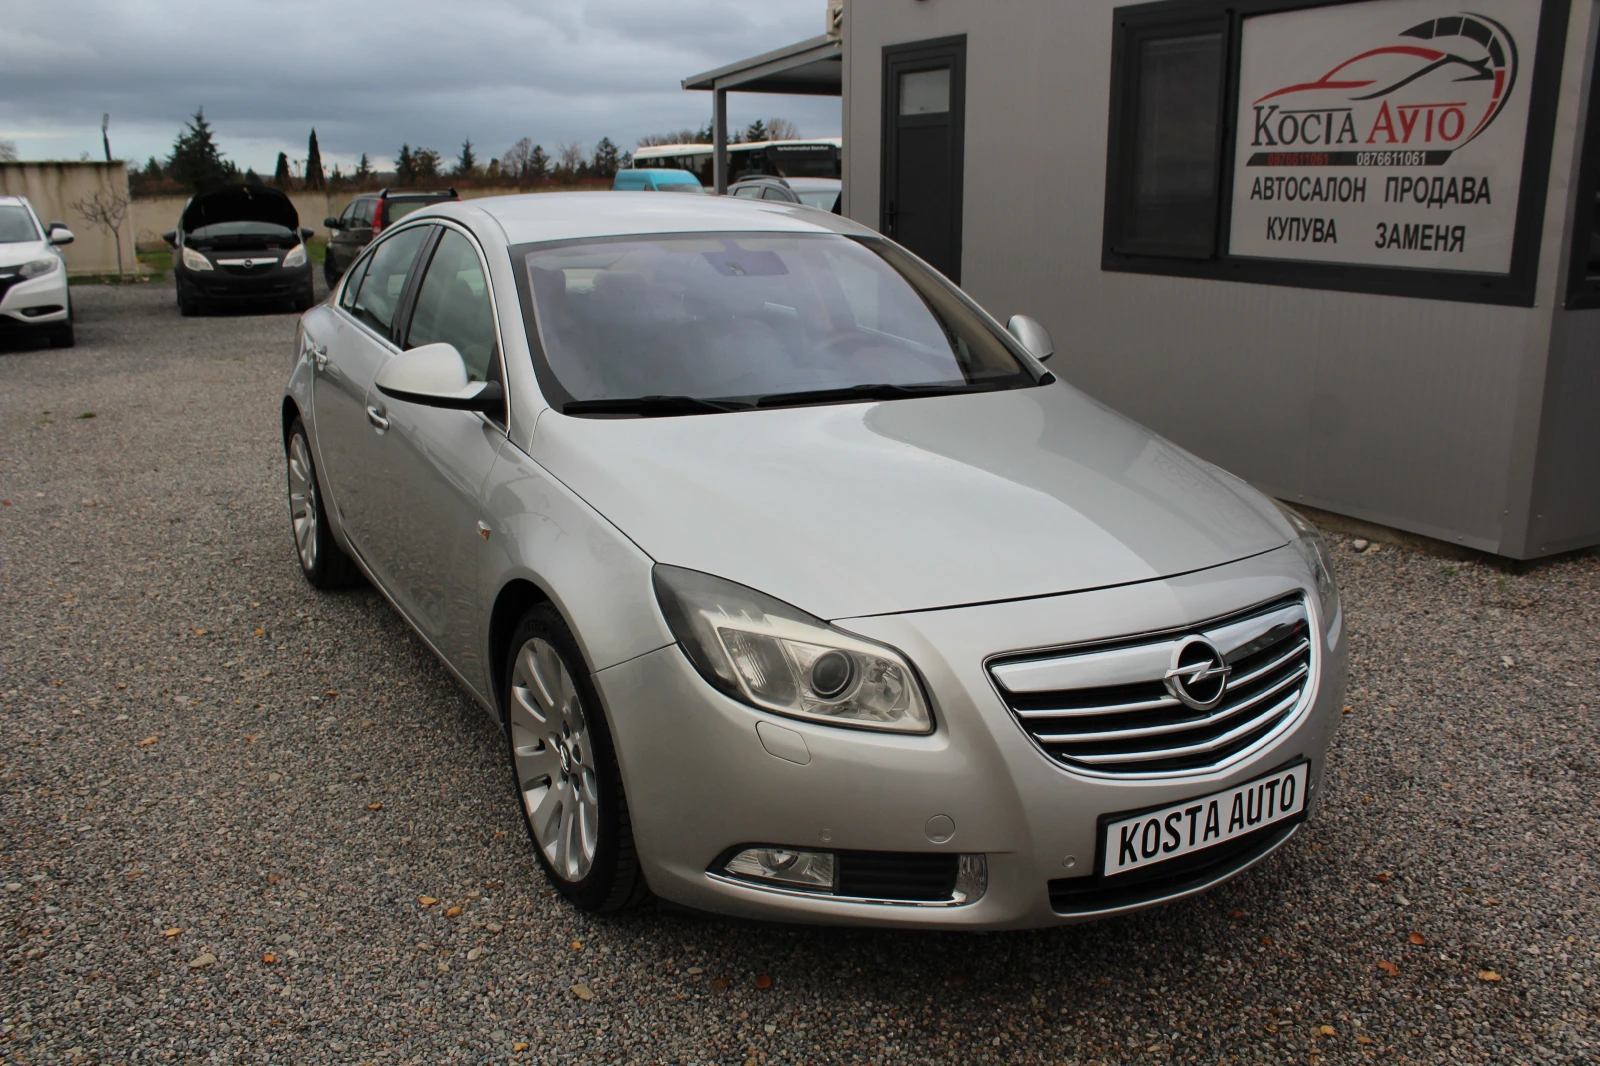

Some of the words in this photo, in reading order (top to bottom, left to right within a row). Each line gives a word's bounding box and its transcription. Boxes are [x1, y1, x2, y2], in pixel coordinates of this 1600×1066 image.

[1251, 105, 1358, 146] КОСТА
[1356, 151, 1426, 166] 0876611061
[1250, 177, 1366, 203] АВТОСАЛОН
[1385, 177, 1491, 208] ПРОДАВА
[1266, 216, 1337, 243] КУПУВА
[1375, 222, 1466, 252] ЗАМЕНЯ
[1119, 800, 1219, 866] KOSTA
[1228, 774, 1296, 833] AUTO
